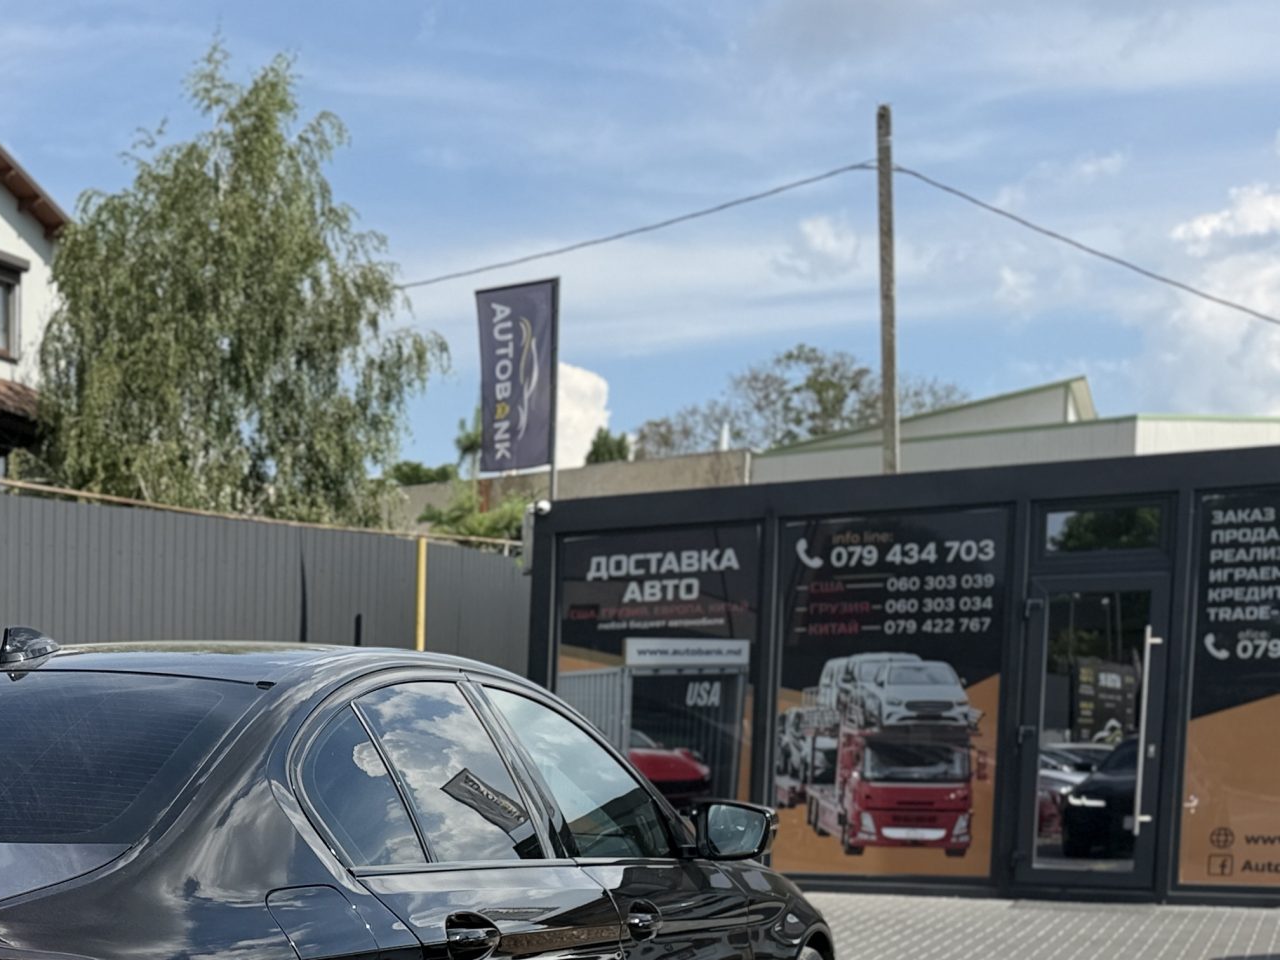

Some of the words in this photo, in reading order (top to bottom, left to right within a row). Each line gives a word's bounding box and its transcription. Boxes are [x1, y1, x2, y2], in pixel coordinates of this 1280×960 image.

[1211, 507, 1276, 525] ЗАКАЗ
[832, 530, 860, 544] info
[1210, 527, 1280, 544] ПРОДА
[830, 545, 879, 567] 079
[885, 542, 937, 565] 434
[944, 539, 995, 563] 703
[586, 548, 740, 581] ДОСТАВКА
[623, 578, 700, 603] АВТО
[887, 576, 920, 592] 060
[923, 575, 957, 590] 303
[961, 574, 995, 589] 039
[885, 599, 918, 614] 060
[922, 597, 955, 612] 303
[959, 596, 993, 611] 034
[808, 621, 859, 635] КИТАЙ
[884, 619, 917, 635] 079
[921, 618, 955, 633] 422
[959, 617, 991, 632] 767
[1236, 640, 1280, 660] 079
[686, 681, 720, 707] USA
